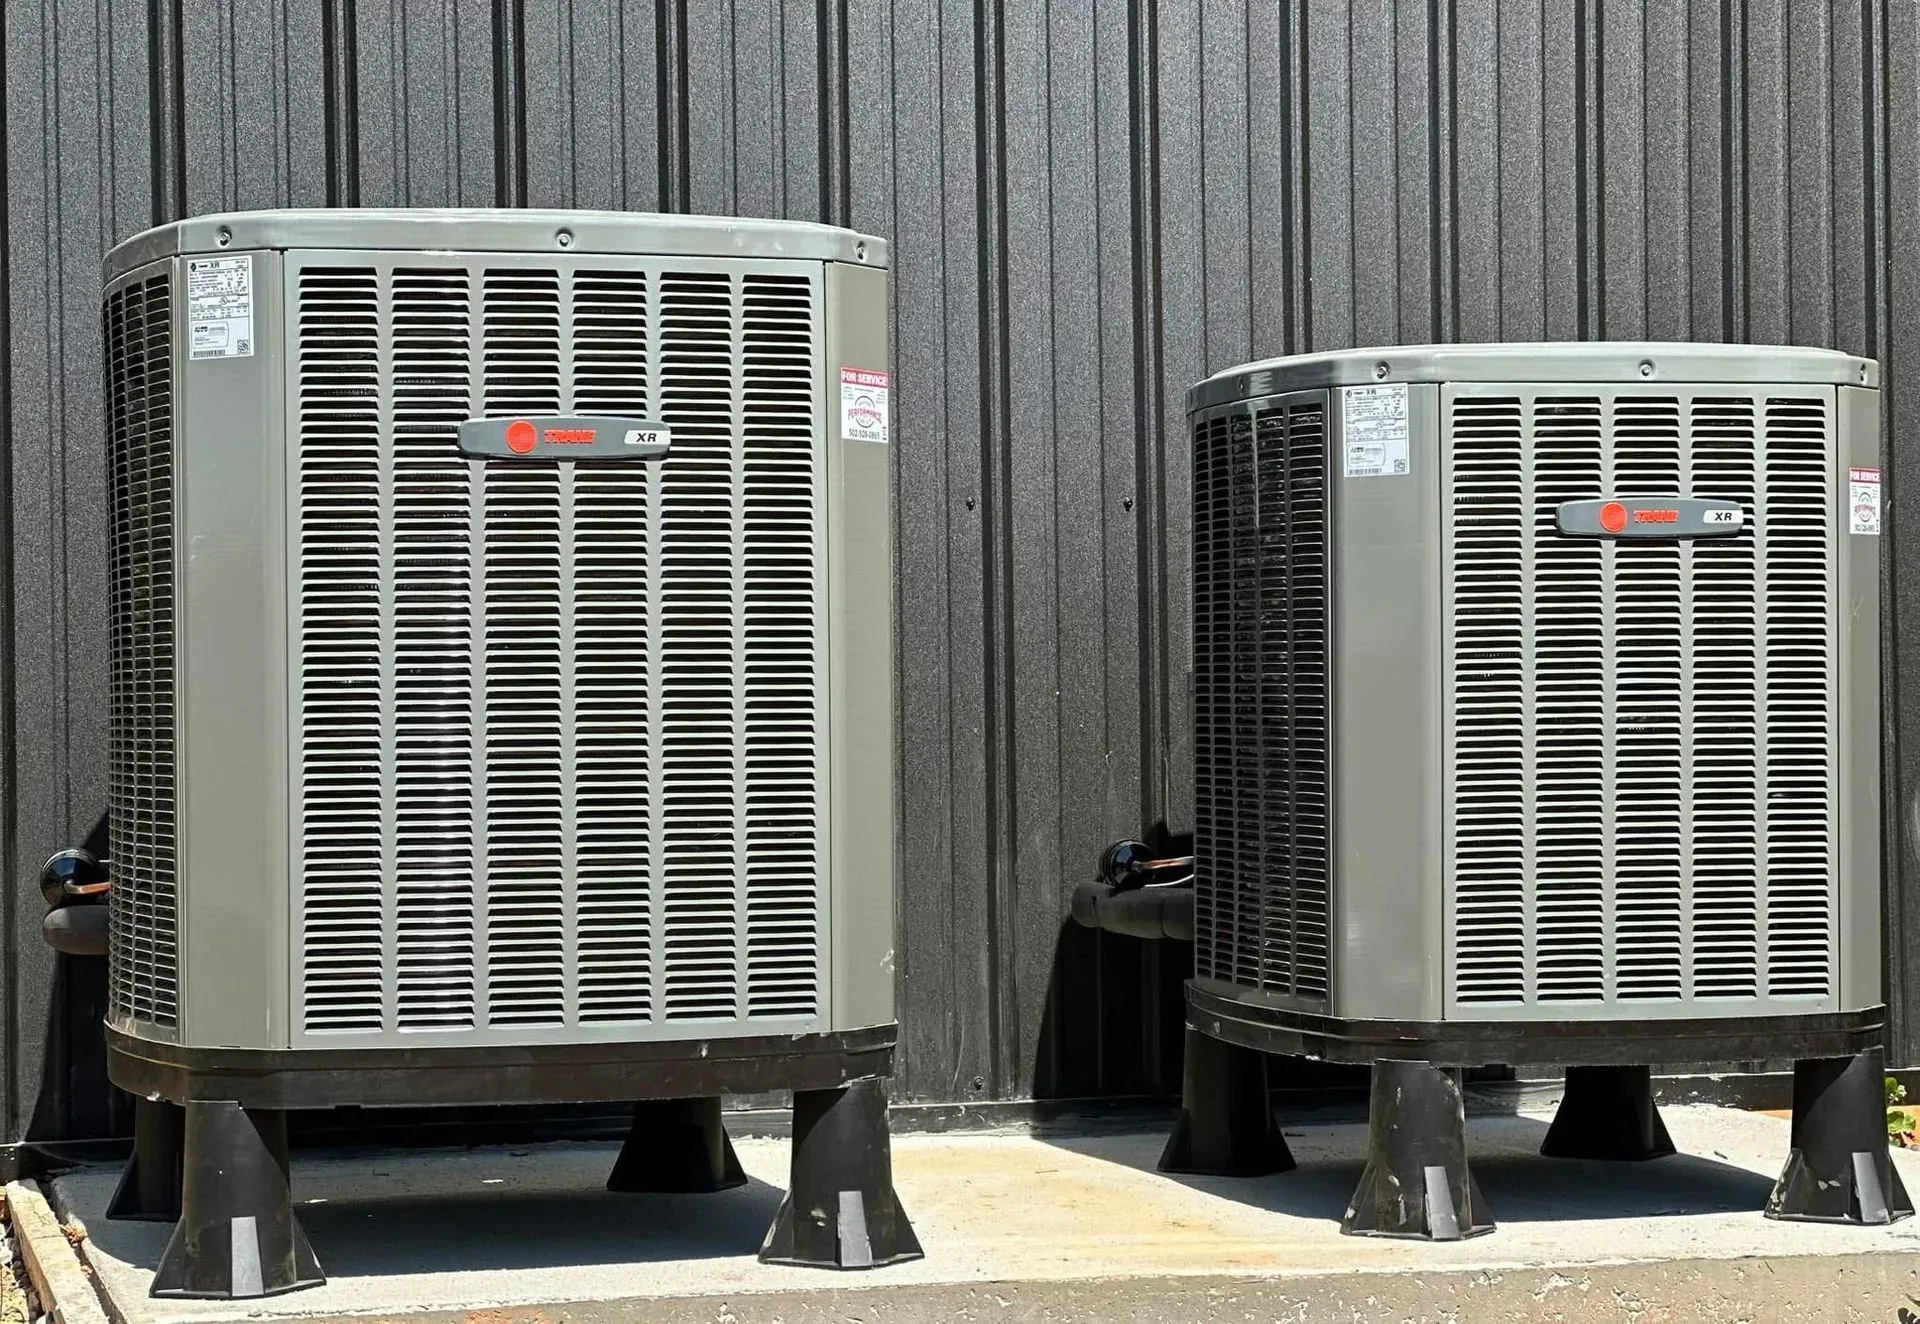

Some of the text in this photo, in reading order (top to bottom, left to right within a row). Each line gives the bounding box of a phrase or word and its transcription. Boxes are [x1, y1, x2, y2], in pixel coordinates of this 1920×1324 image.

[842, 371, 887, 387] FOR SERVICE
[544, 429, 657, 444] TRANE XR
[1634, 509, 1732, 523] TRANE XR
